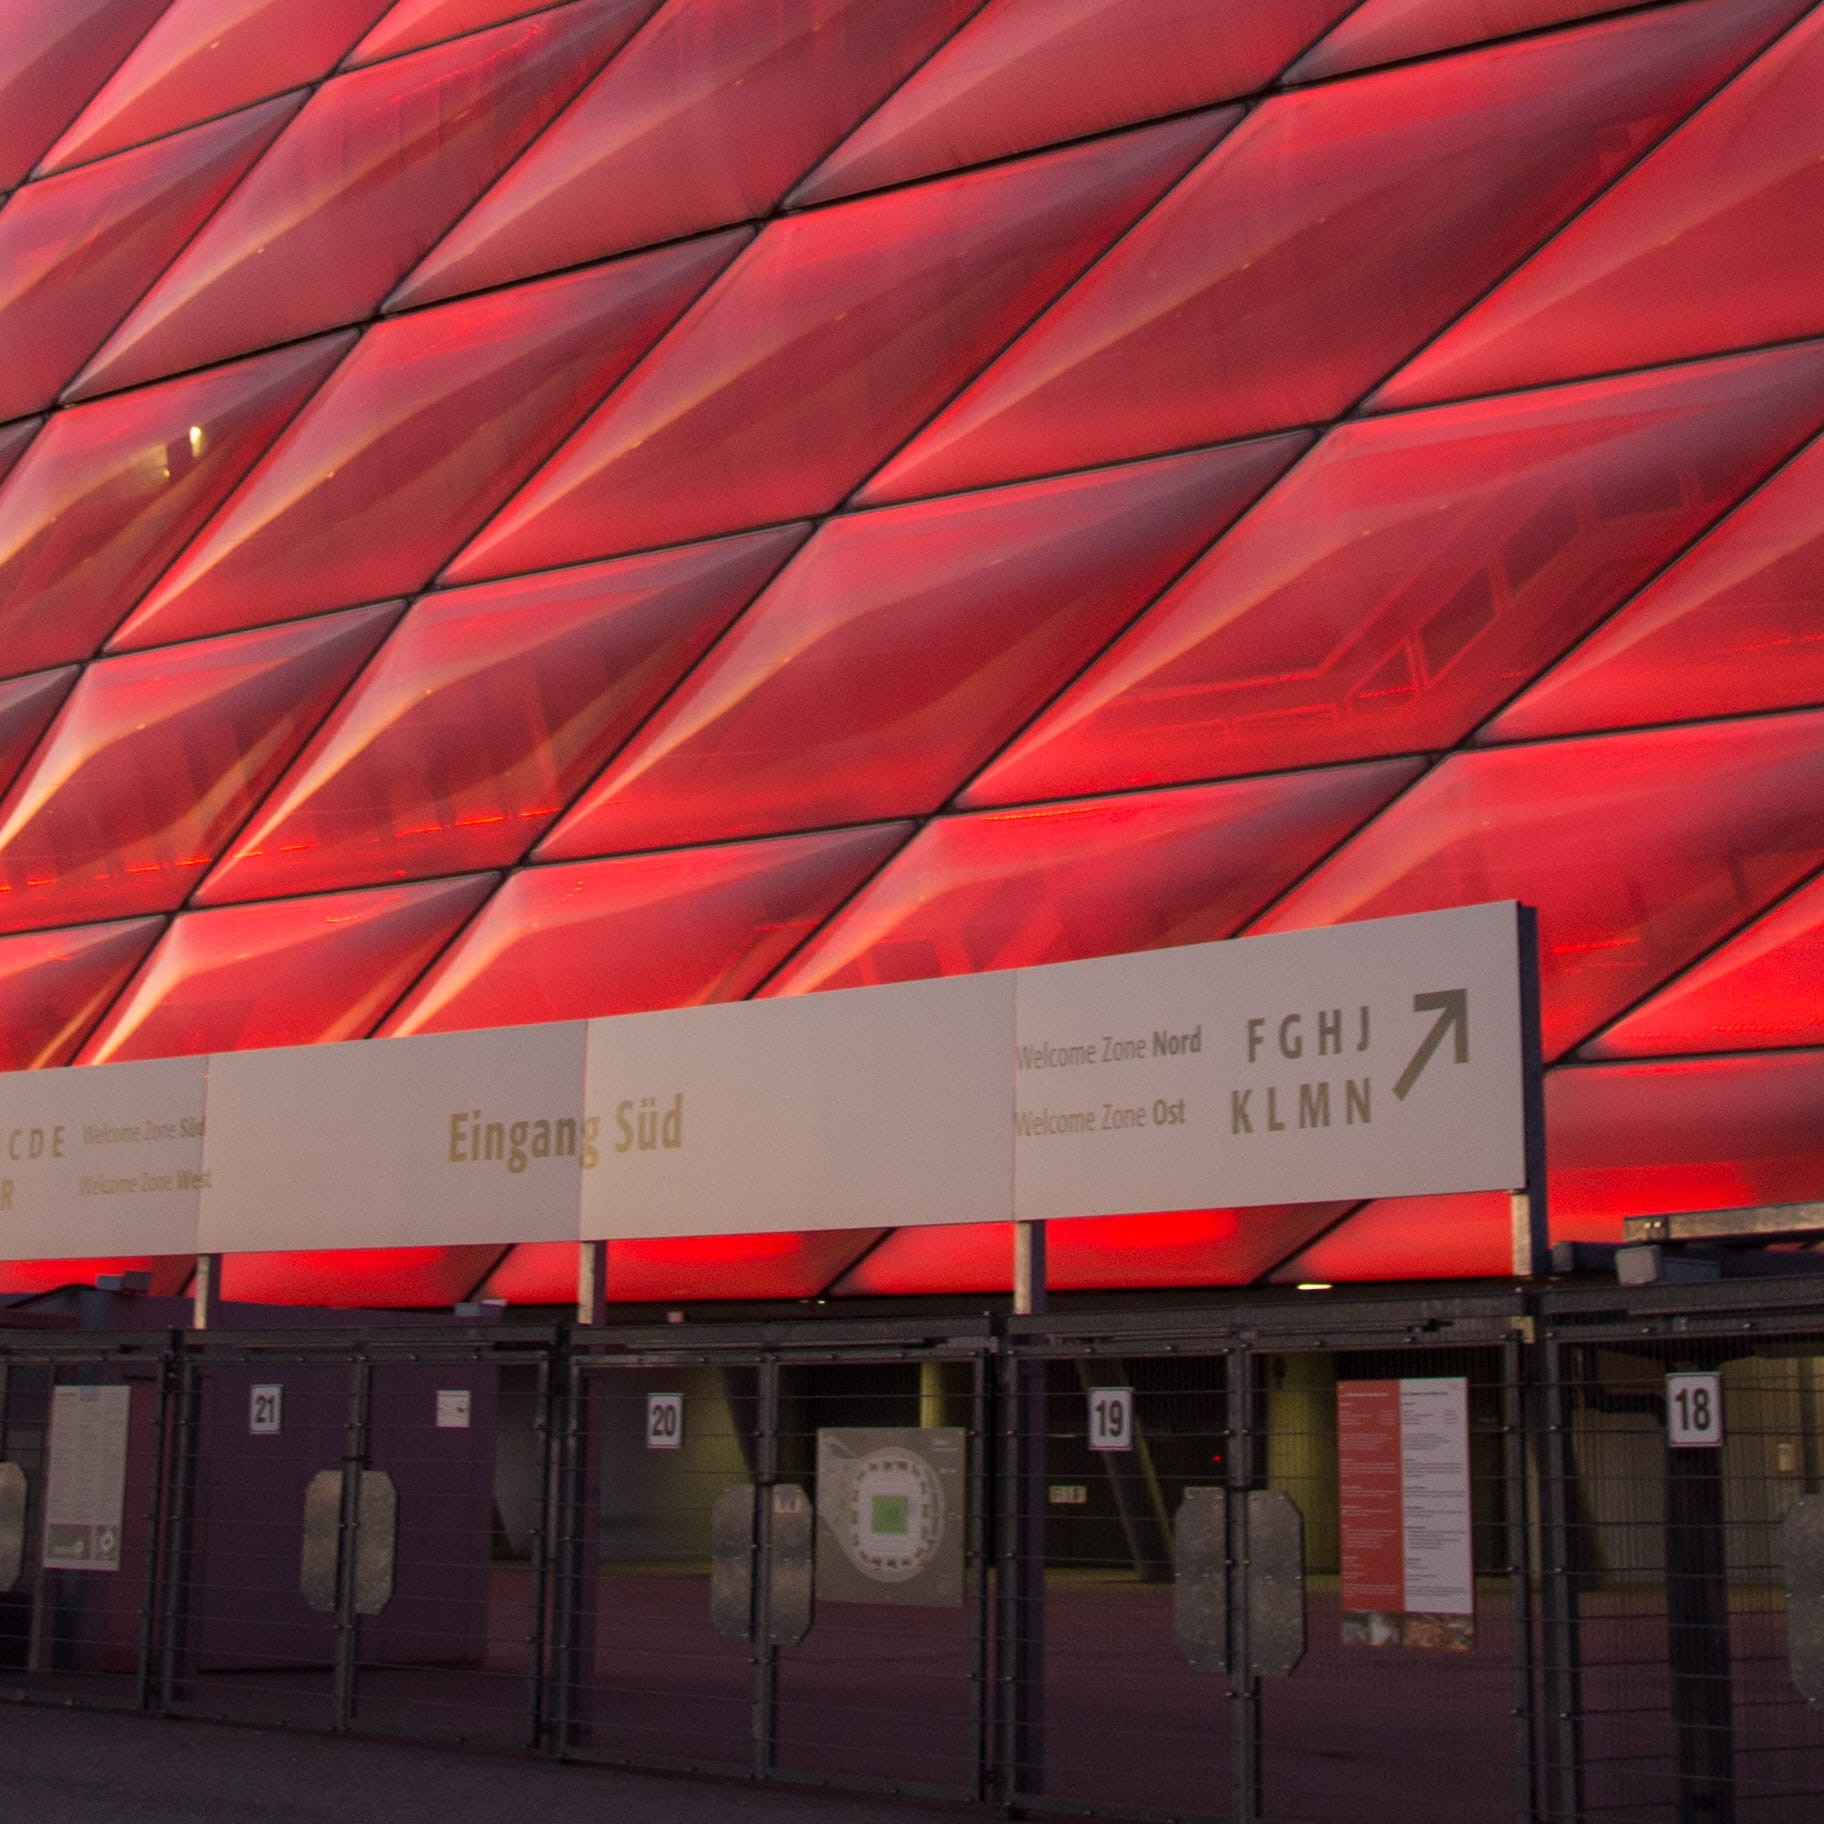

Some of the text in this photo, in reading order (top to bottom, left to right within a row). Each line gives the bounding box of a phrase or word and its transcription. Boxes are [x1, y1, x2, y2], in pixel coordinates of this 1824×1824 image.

[1016, 1042, 1096, 1071] Welcome
[1101, 1036, 1146, 1063] Zone
[1152, 1024, 1202, 1058] Nord
[448, 1092, 683, 1173] Eingang Süd
[1015, 1108, 1096, 1137] Welcome
[1101, 1103, 1146, 1130] Zone
[1152, 1098, 1186, 1126] Ost
[255, 1394, 275, 1423] 21
[652, 1404, 676, 1436] 20
[1095, 1399, 1122, 1436] 19
[1675, 1387, 1710, 1431] 18
